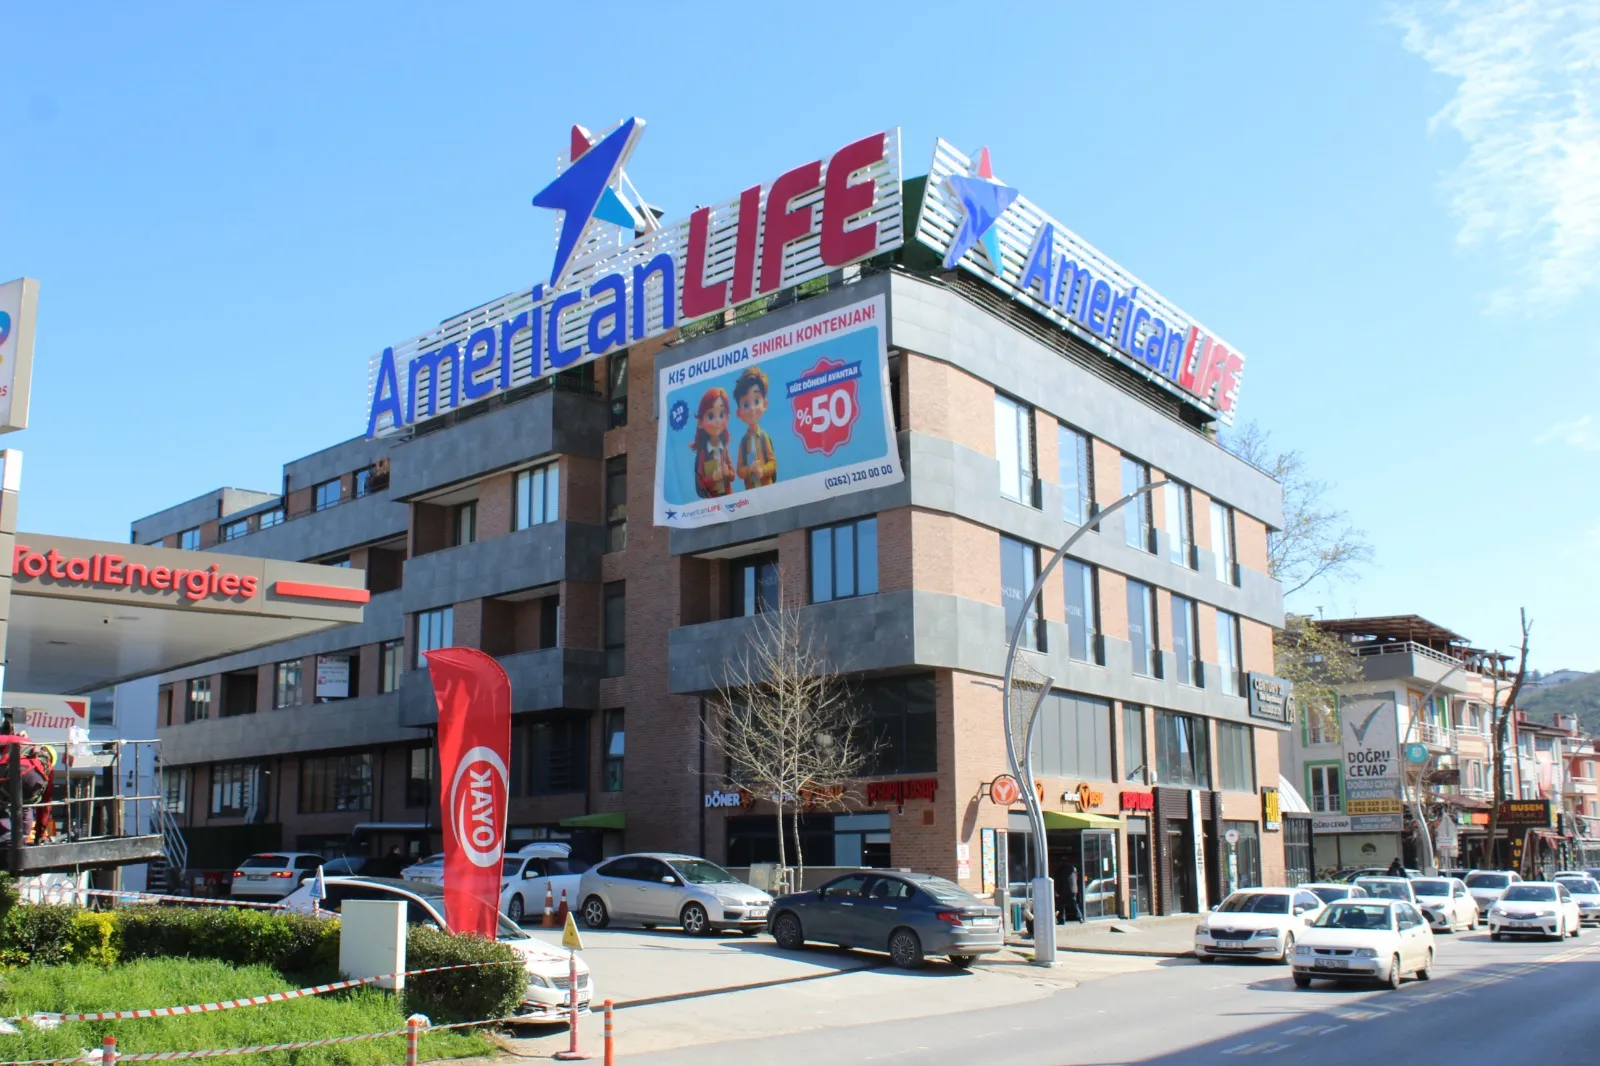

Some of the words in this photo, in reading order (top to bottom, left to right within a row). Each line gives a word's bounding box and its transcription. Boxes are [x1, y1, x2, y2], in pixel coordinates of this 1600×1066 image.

[668, 369, 686, 385] KIŞ
[688, 347, 749, 378] OKULUNDA
[752, 332, 793, 358] SINIRLI
[796, 304, 875, 343] KONTENJAN!
[825, 473, 851, 490] (0262)
[852, 470, 867, 482] 220
[868, 467, 880, 478] 00
[881, 464, 893, 475] 00
[13, 545, 259, 600] TotalEnergies
[25, 711, 76, 729] ellium
[1348, 747, 1390, 763] DOĞRU
[1350, 764, 1387, 777] CEVAP
[705, 790, 740, 808] DÖNER
[1313, 821, 1330, 829] OĞRU
